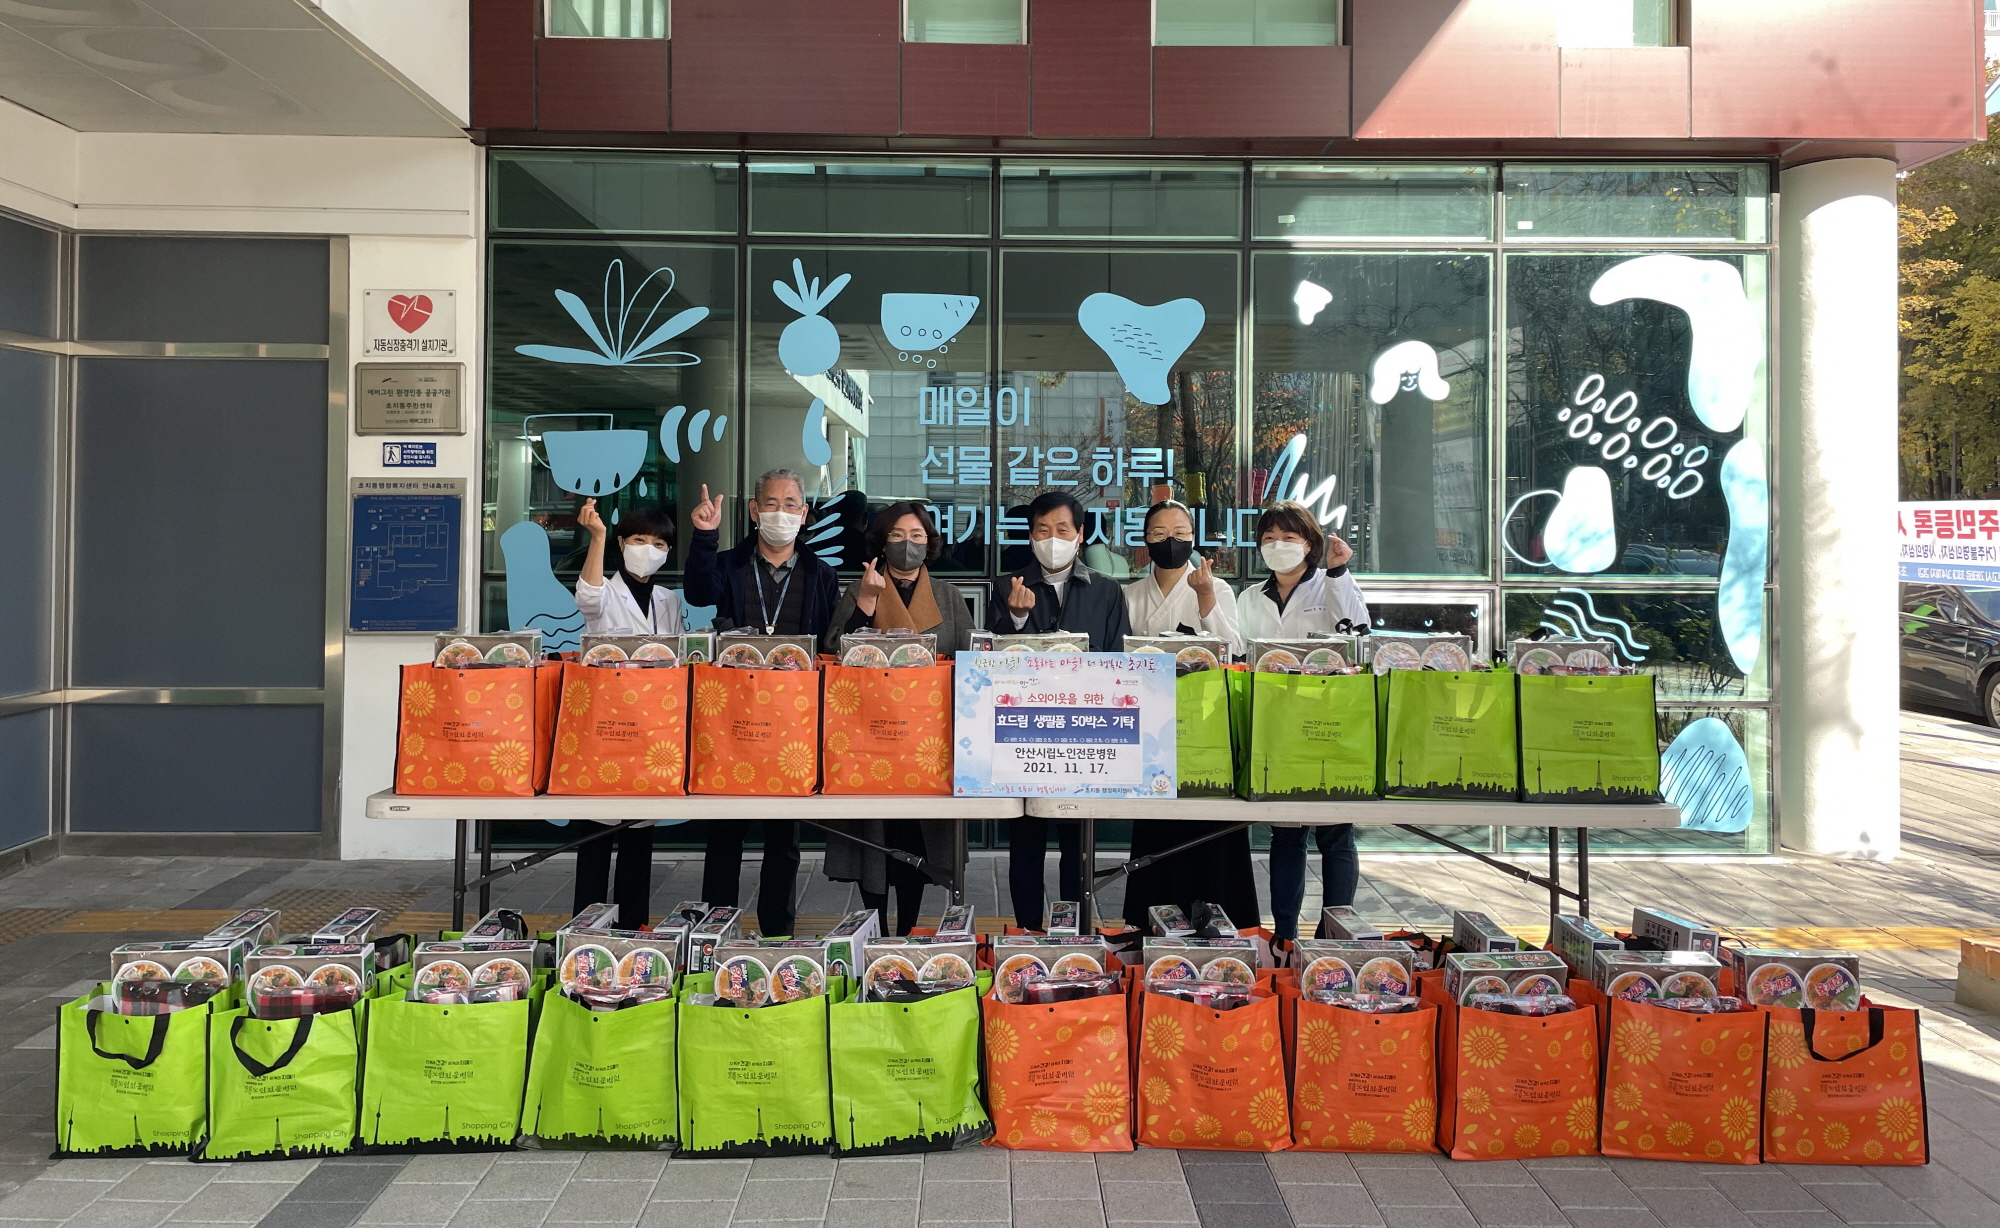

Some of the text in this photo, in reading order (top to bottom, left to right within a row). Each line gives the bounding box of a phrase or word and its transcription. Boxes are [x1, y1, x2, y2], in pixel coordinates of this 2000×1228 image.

[373, 339, 448, 352] 자동심장충격기 설치기관
[367, 389, 451, 398] 에버그린 환경인증 공공기관
[386, 402, 433, 410] 초지동주민센터
[919, 386, 1030, 427] 매일이
[919, 445, 1174, 487] 선물 같은 하루!
[1027, 657, 1055, 670] 소통하는
[1060, 657, 1083, 671] 마을!
[1128, 657, 1157, 673] 초지동
[1027, 692, 1105, 705] 소외이웃을 위한
[1033, 714, 1066, 729] 생필품
[1071, 715, 1108, 729] 50박스
[1112, 715, 1135, 730] 기탁
[1015, 747, 1117, 760] 안산시립노인전문병원
[1023, 763, 1108, 775] 2021. 11. 17.
[1184, 767, 1226, 777] Shopping City
[1472, 771, 1514, 780] Shopping City
[1334, 775, 1363, 783] Shopping
[1612, 774, 1641, 783] Shopping
[1315, 971, 1346, 987] 육개장
[1365, 970, 1404, 994] 육개장
[1816, 974, 1844, 997] 육개장
[1763, 977, 1792, 995] 육개장
[963, 1104, 977, 1118] City
[462, 1120, 514, 1131] Shopping City
[615, 1117, 667, 1130] Shopping City
[775, 1120, 826, 1131] Shopping City
[153, 1129, 189, 1139] Shopping
[294, 1130, 348, 1141] Shopping City
